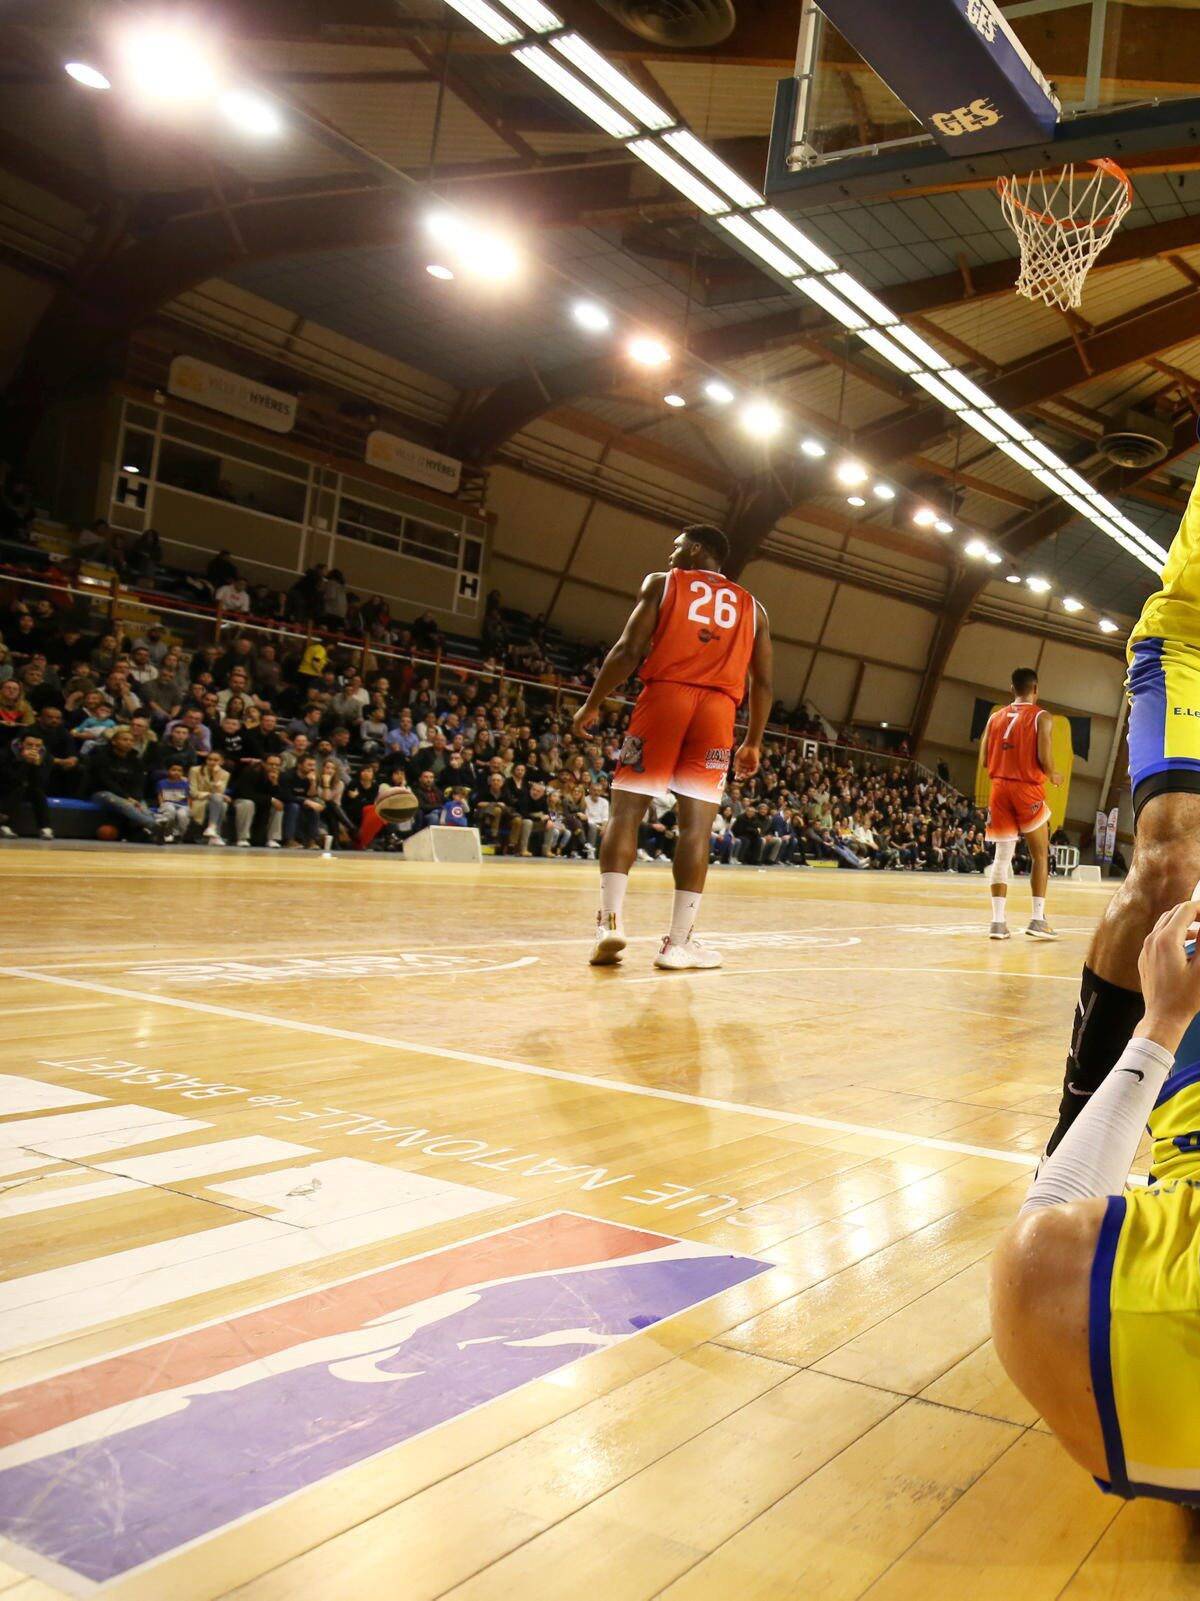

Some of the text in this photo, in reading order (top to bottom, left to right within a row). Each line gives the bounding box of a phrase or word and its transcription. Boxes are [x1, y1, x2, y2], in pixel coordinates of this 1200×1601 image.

[930, 98, 1002, 136] GES
[116, 477, 148, 509] H
[459, 575, 478, 598] H
[688, 581, 738, 629] 26
[1003, 712, 1019, 739] 7
[38, 1057, 251, 1100] BASKET
[247, 1094, 303, 1108] de
[276, 1106, 636, 1192] NATIONALE
